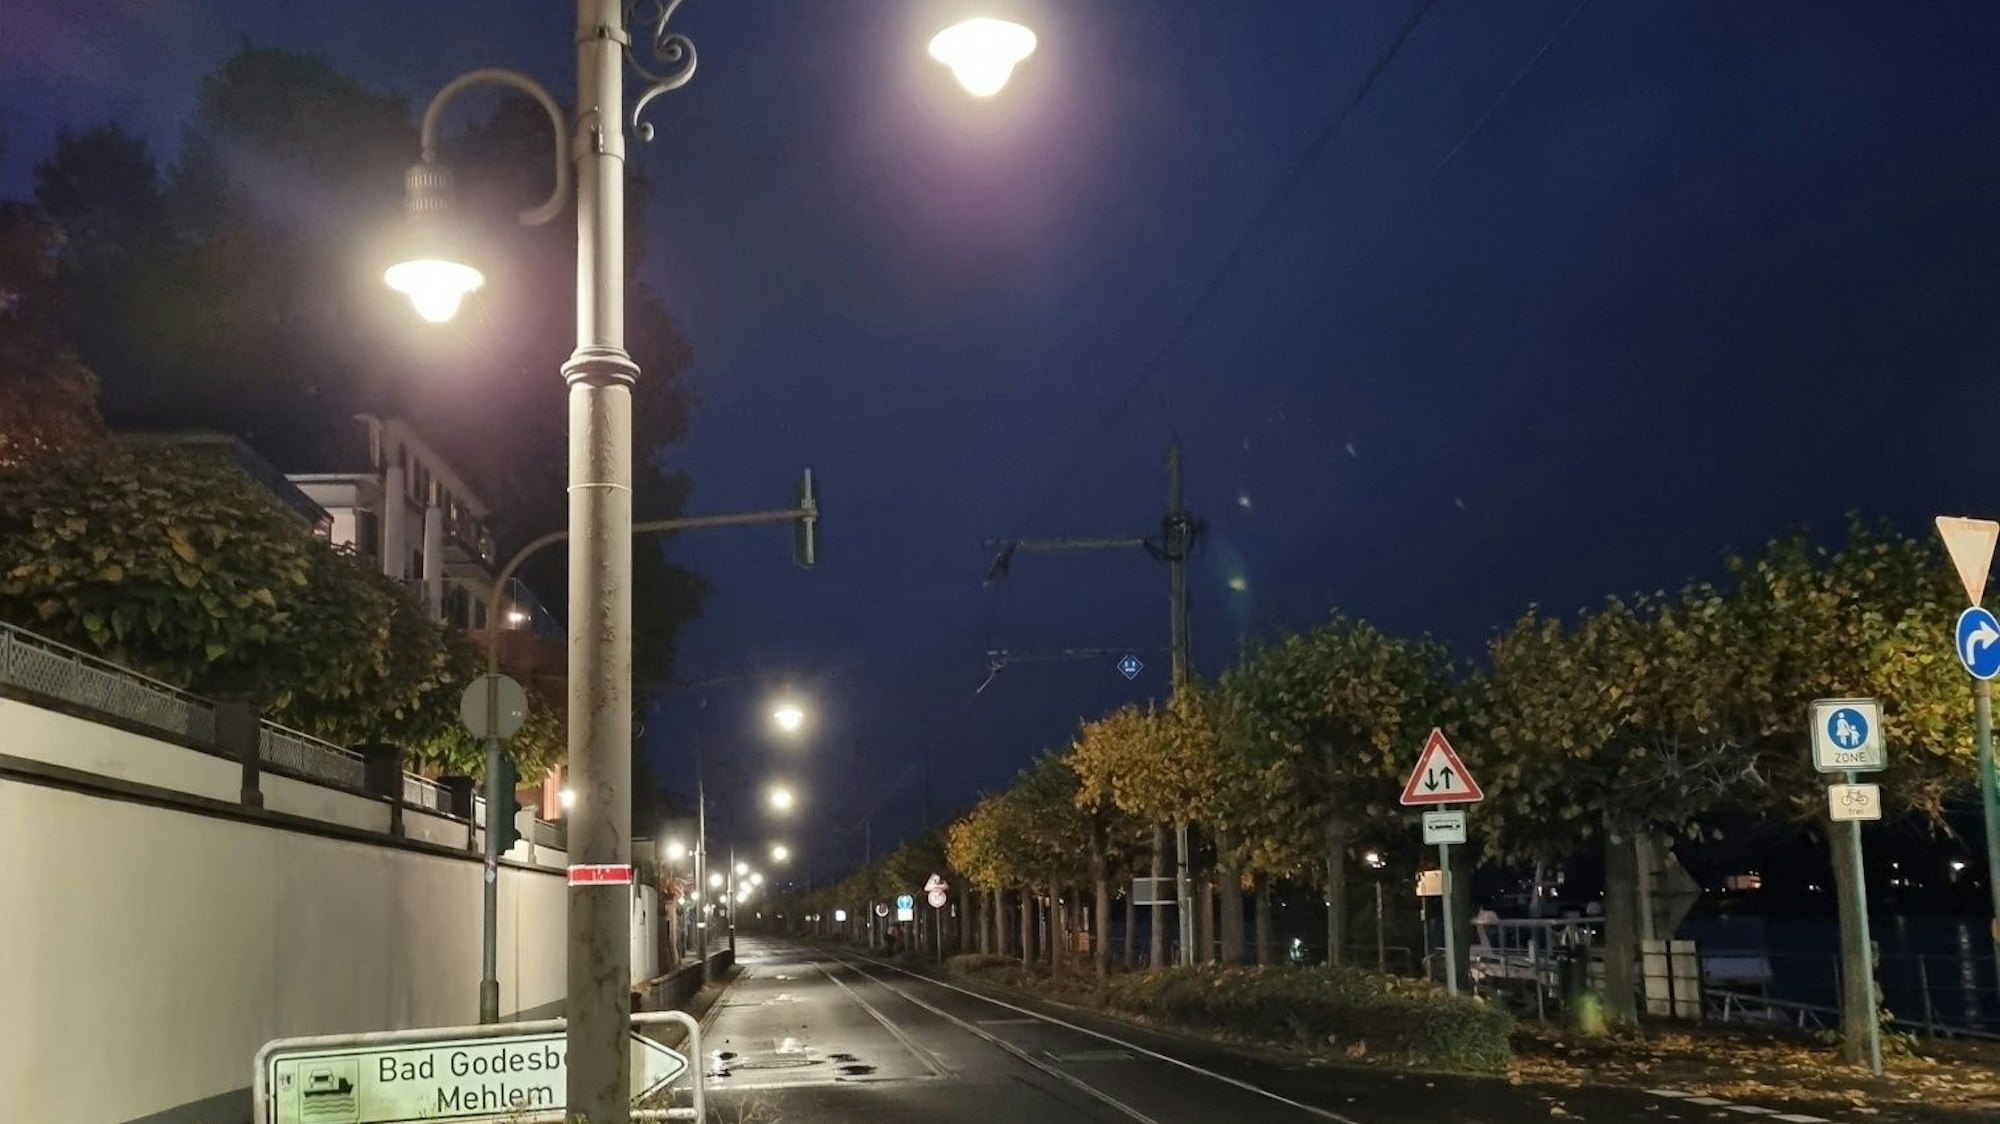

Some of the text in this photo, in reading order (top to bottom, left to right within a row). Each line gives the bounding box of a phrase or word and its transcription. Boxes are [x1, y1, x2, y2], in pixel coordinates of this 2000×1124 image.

[1835, 752, 1867, 763] ZONE
[379, 1045, 567, 1082] Bad Godesb
[437, 1083, 553, 1112] Mehlem
